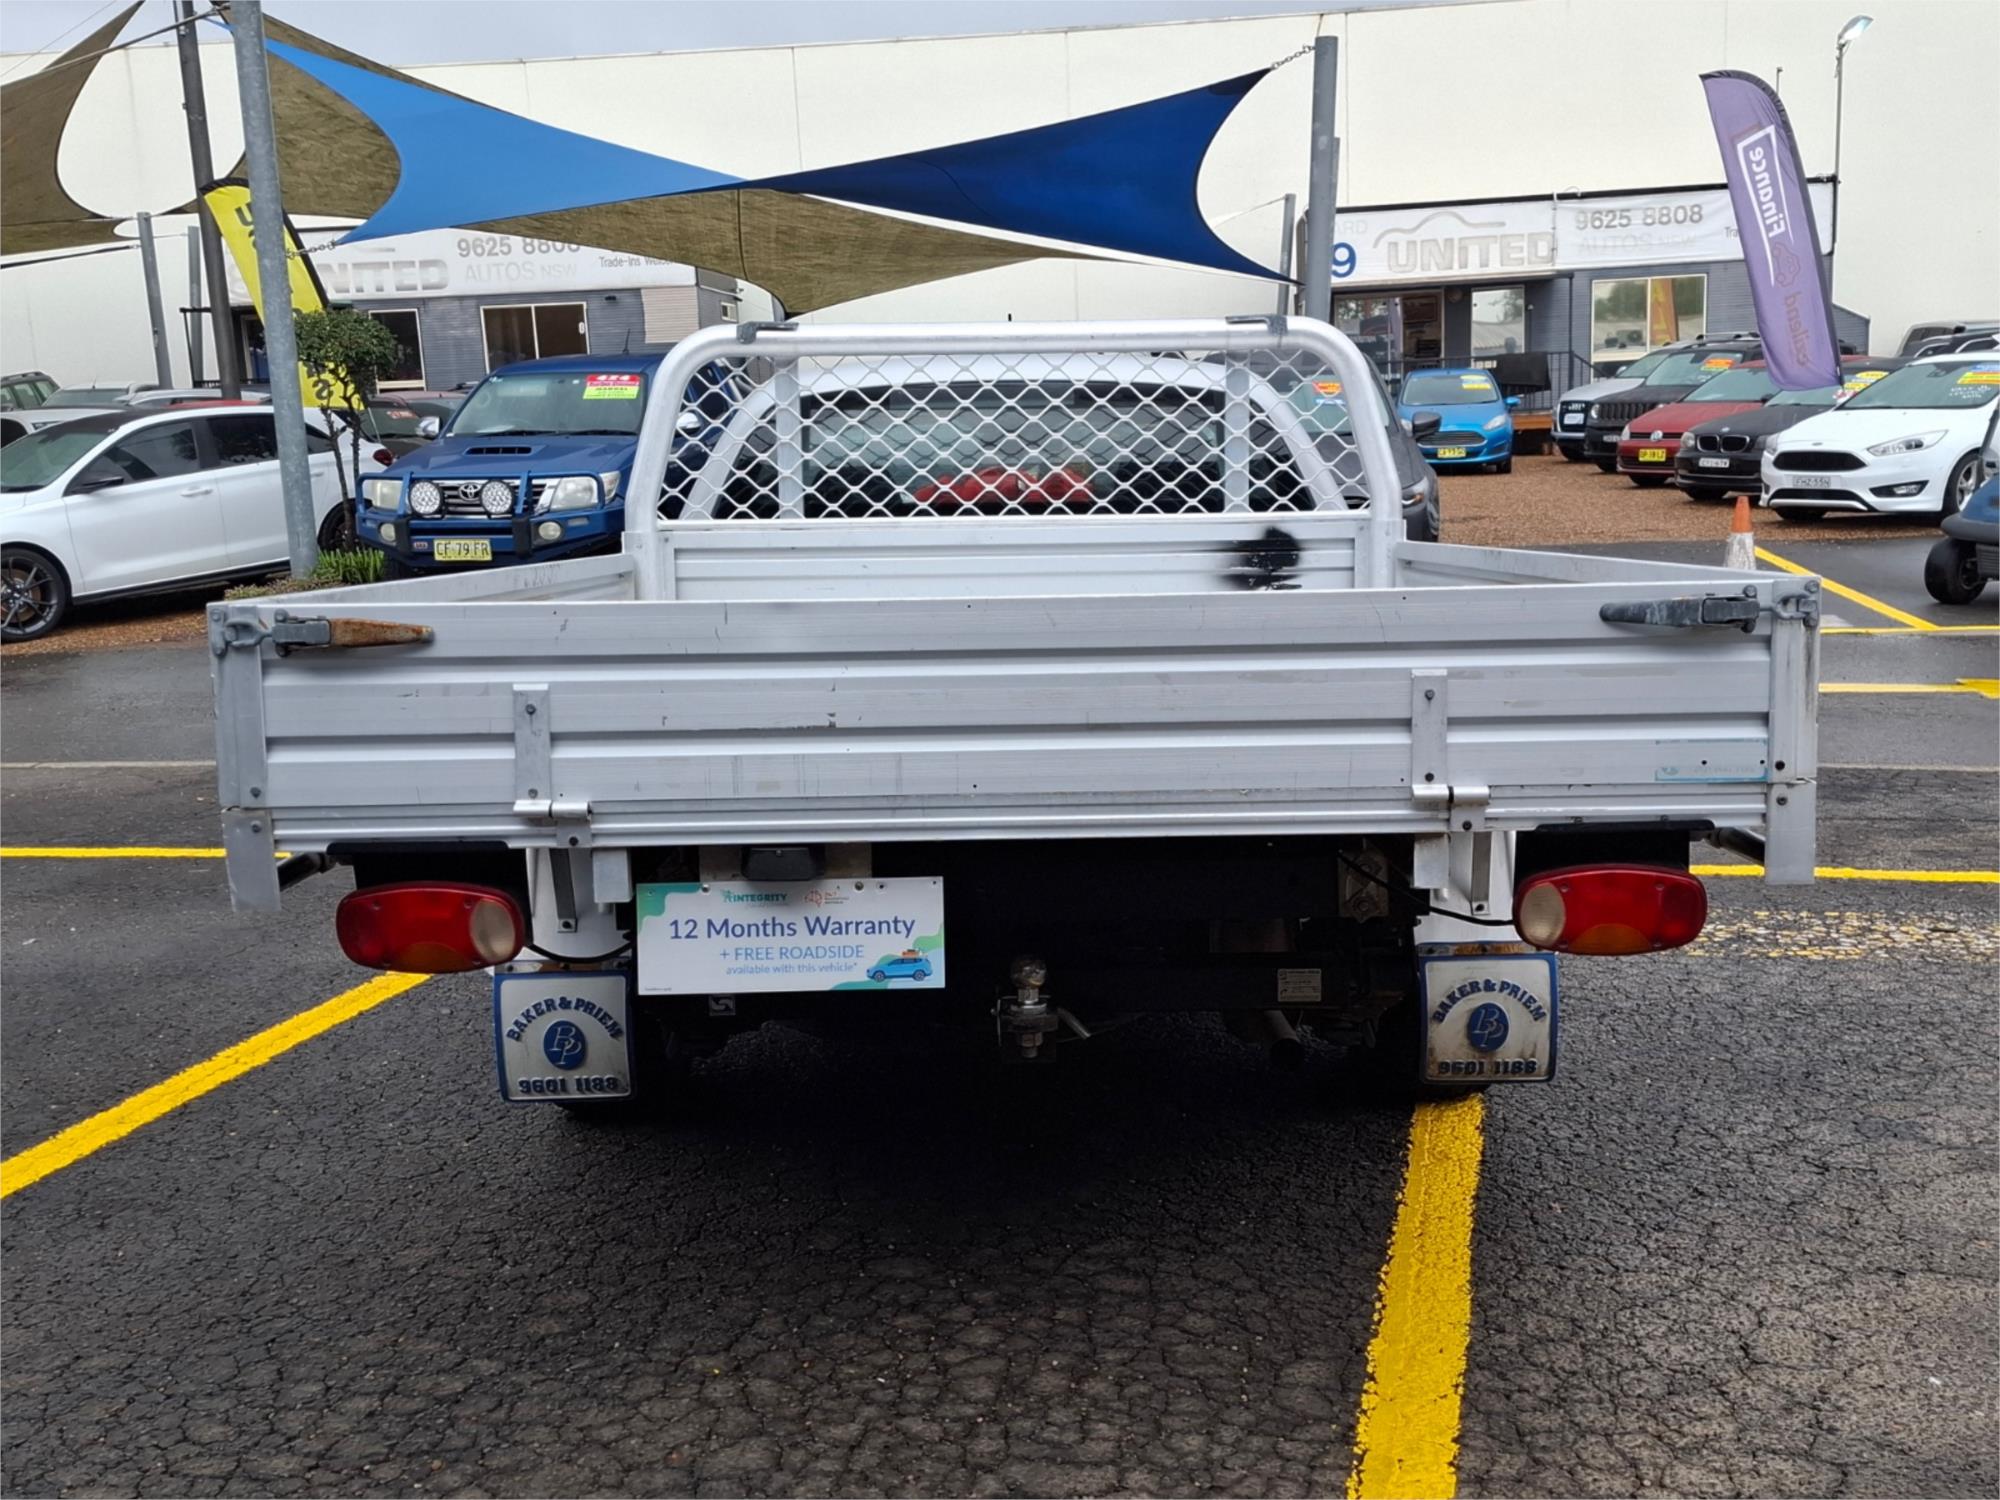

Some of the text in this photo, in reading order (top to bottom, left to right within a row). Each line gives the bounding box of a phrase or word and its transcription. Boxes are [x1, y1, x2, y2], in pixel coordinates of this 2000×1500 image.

[1576, 203, 1703, 230] 9625 8808
[456, 236, 512, 258] 9625
[1387, 231, 1553, 274] UNITED
[316, 259, 449, 294] NITED
[465, 260, 577, 283] AUTOS NSW
[669, 915, 916, 939] 12 Months Warranty
[734, 946, 775, 961] FREE
[779, 944, 865, 960] ROADSIDE
[726, 963, 771, 975] available
[772, 963, 796, 973] with
[797, 963, 816, 973] this
